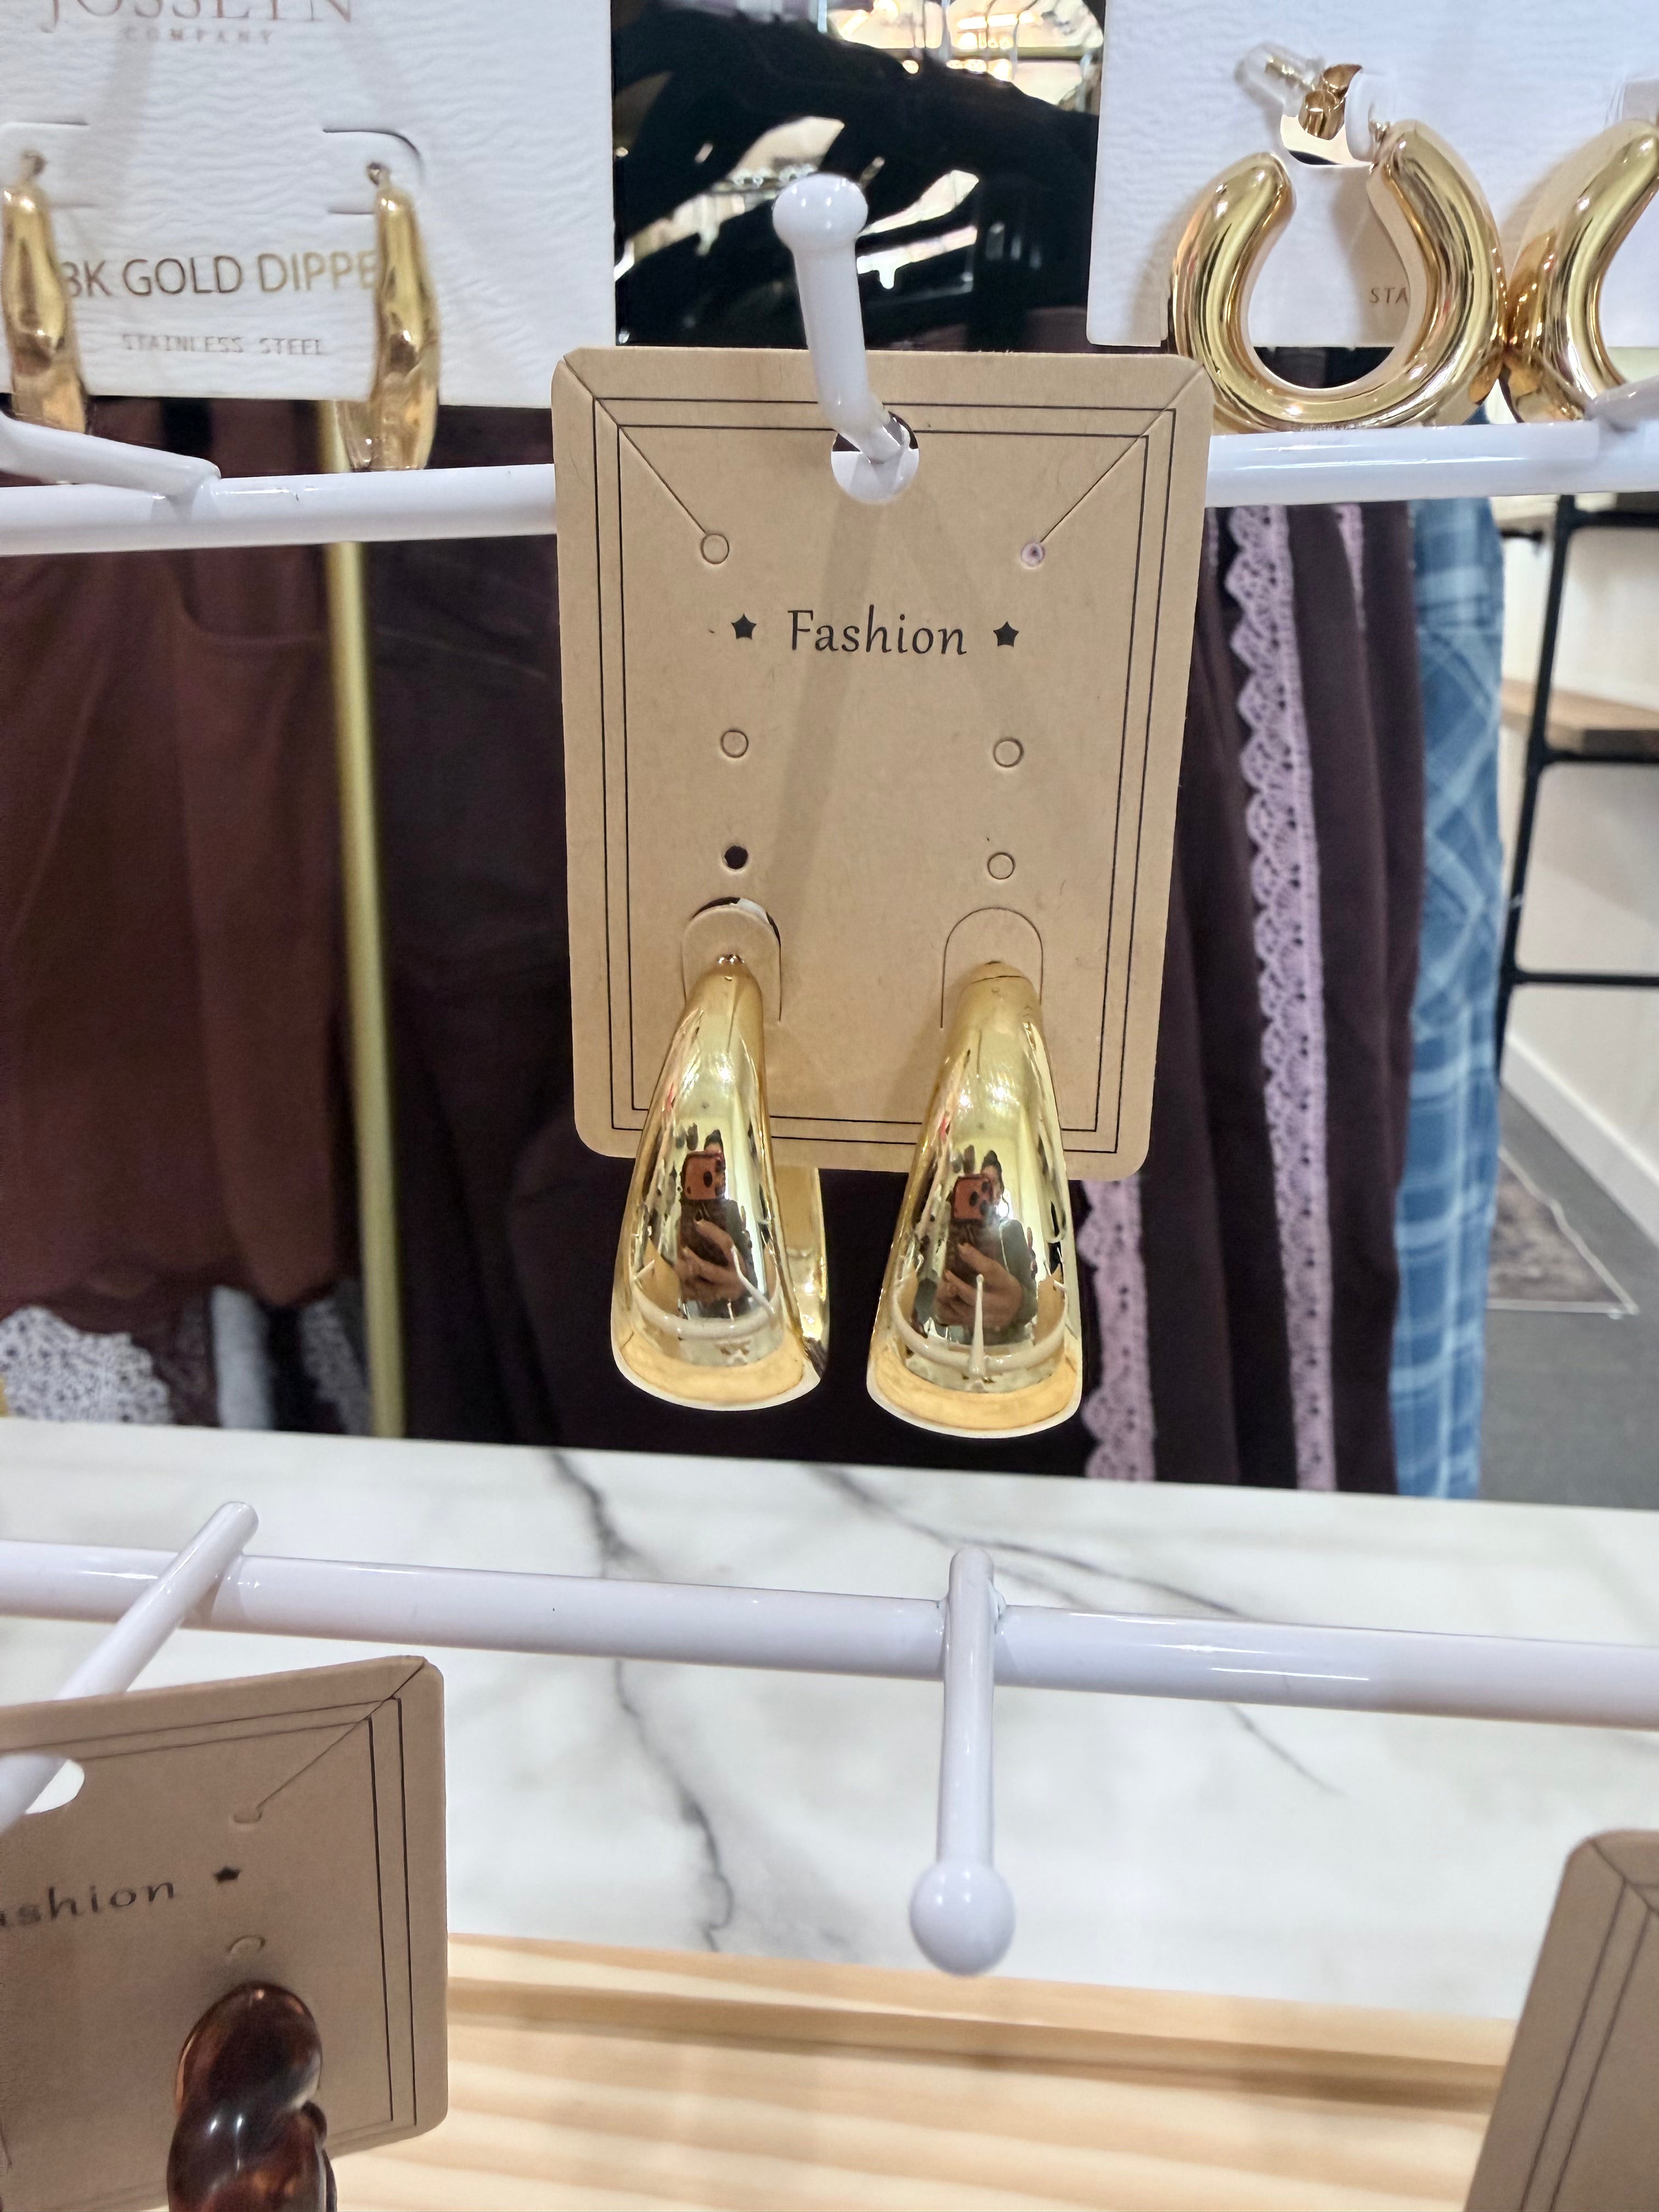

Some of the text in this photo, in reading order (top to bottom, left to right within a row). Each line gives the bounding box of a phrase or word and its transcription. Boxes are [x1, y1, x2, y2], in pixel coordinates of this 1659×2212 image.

[58, 250, 379, 297] 8K GOLD DIPPE
[1369, 286, 1409, 304] STA
[121, 333, 329, 356] STAINLESS STEEL
[787, 604, 967, 655] Fashion
[0, 1881, 174, 1927] shion
